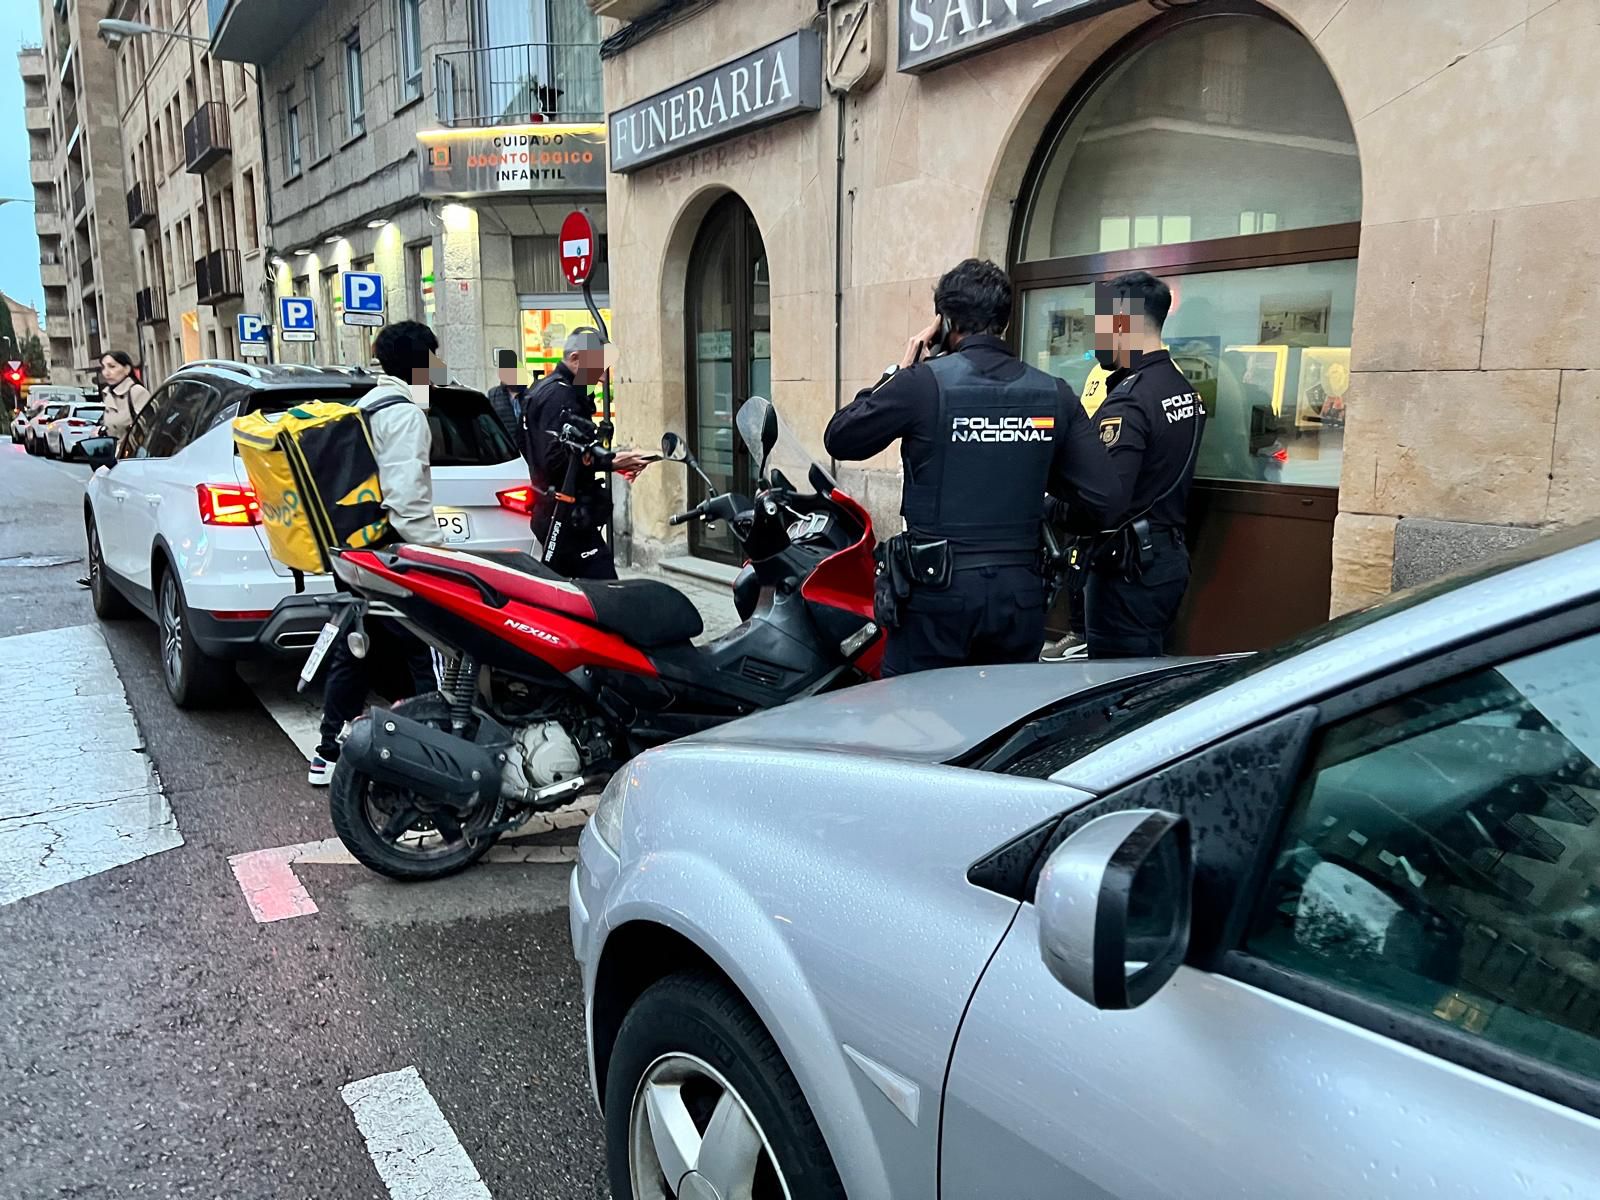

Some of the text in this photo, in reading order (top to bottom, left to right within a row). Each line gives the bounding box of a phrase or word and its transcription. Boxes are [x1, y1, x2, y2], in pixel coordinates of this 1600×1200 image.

[909, 0, 1050, 51] SAN
[615, 51, 792, 161] FUNERARIA
[494, 134, 564, 148] CUIDADO
[467, 151, 593, 168] ODONTOLOGICO
[496, 168, 565, 181] INFANTIL
[350, 276, 376, 308] P
[287, 302, 307, 326] P
[243, 317, 263, 339] P
[952, 417, 1036, 429] POLICIA
[951, 430, 1053, 442] NACIONAL
[504, 618, 560, 644] NEXUS
